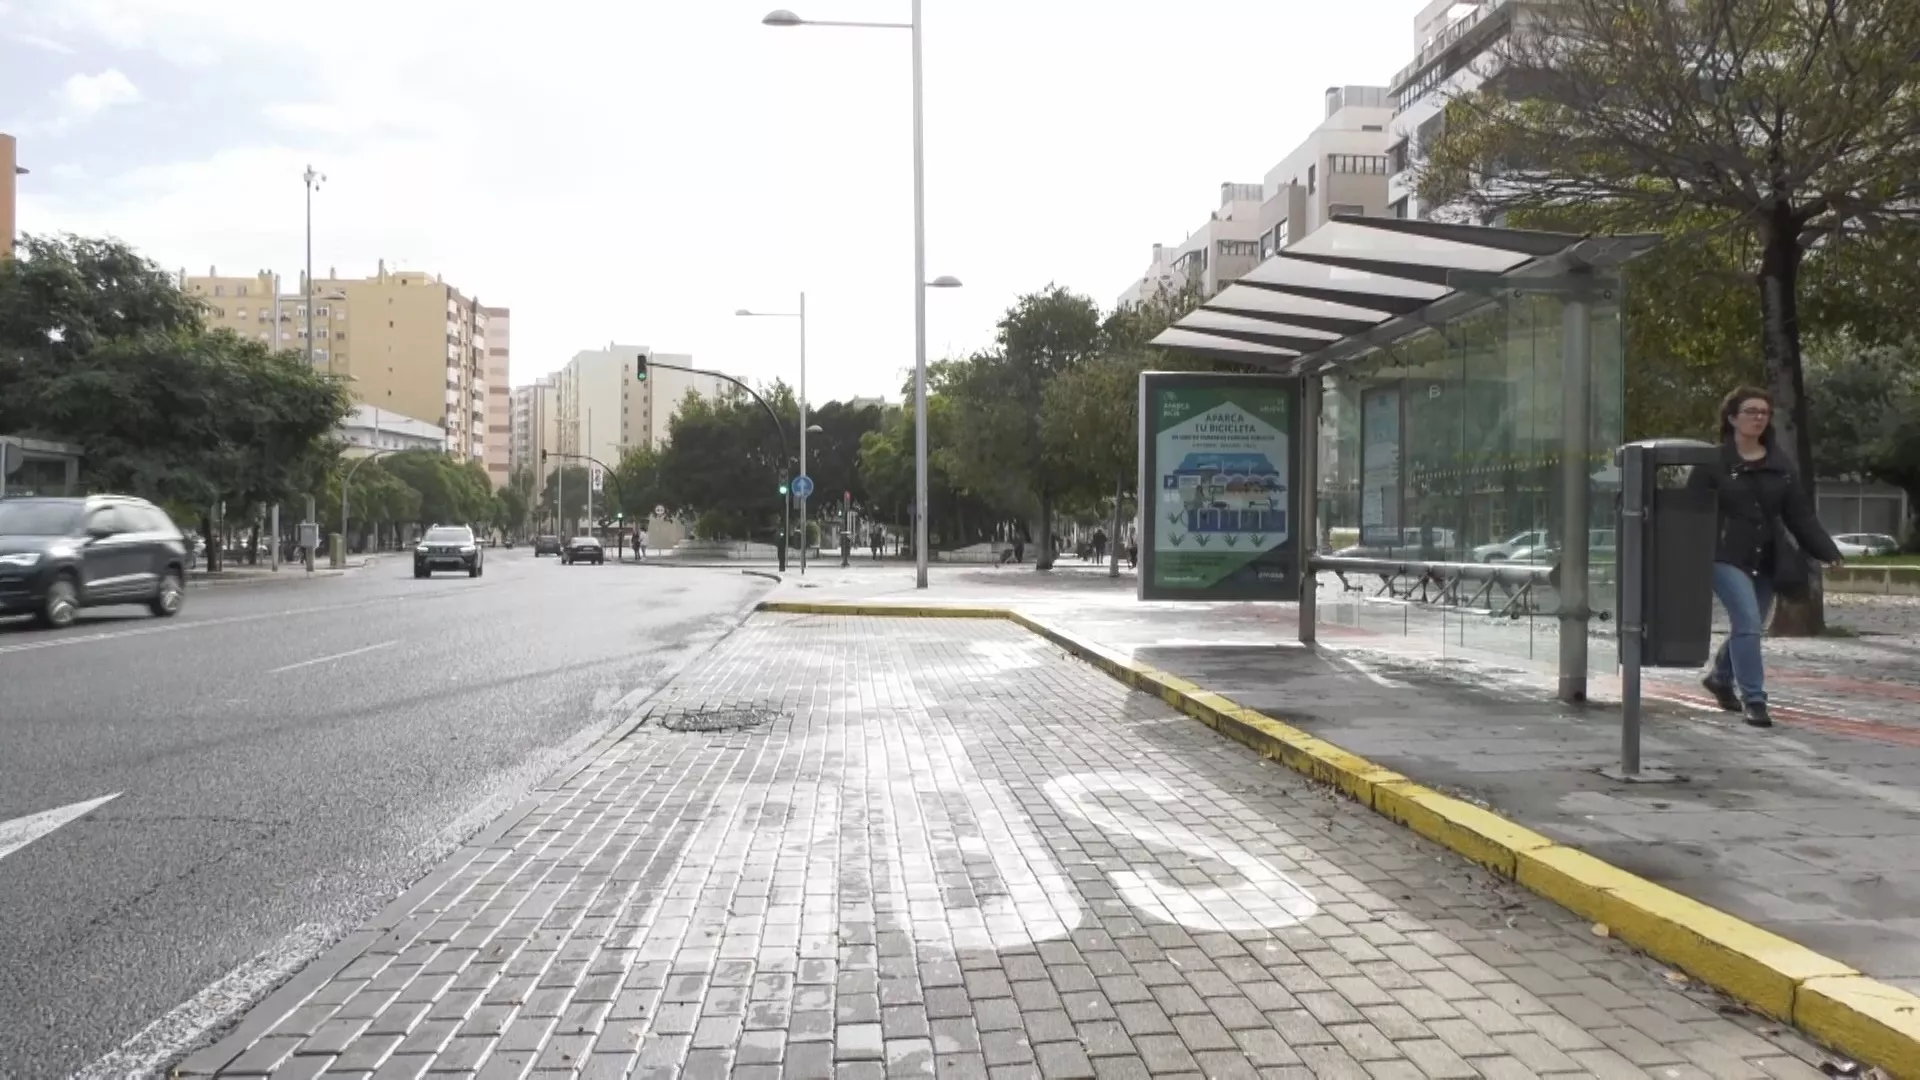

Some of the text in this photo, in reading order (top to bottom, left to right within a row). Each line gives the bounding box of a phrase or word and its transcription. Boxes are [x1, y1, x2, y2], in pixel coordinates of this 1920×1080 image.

[1206, 413, 1245, 422] APARCA
[1195, 423, 1256, 433] TU BICICLETA
